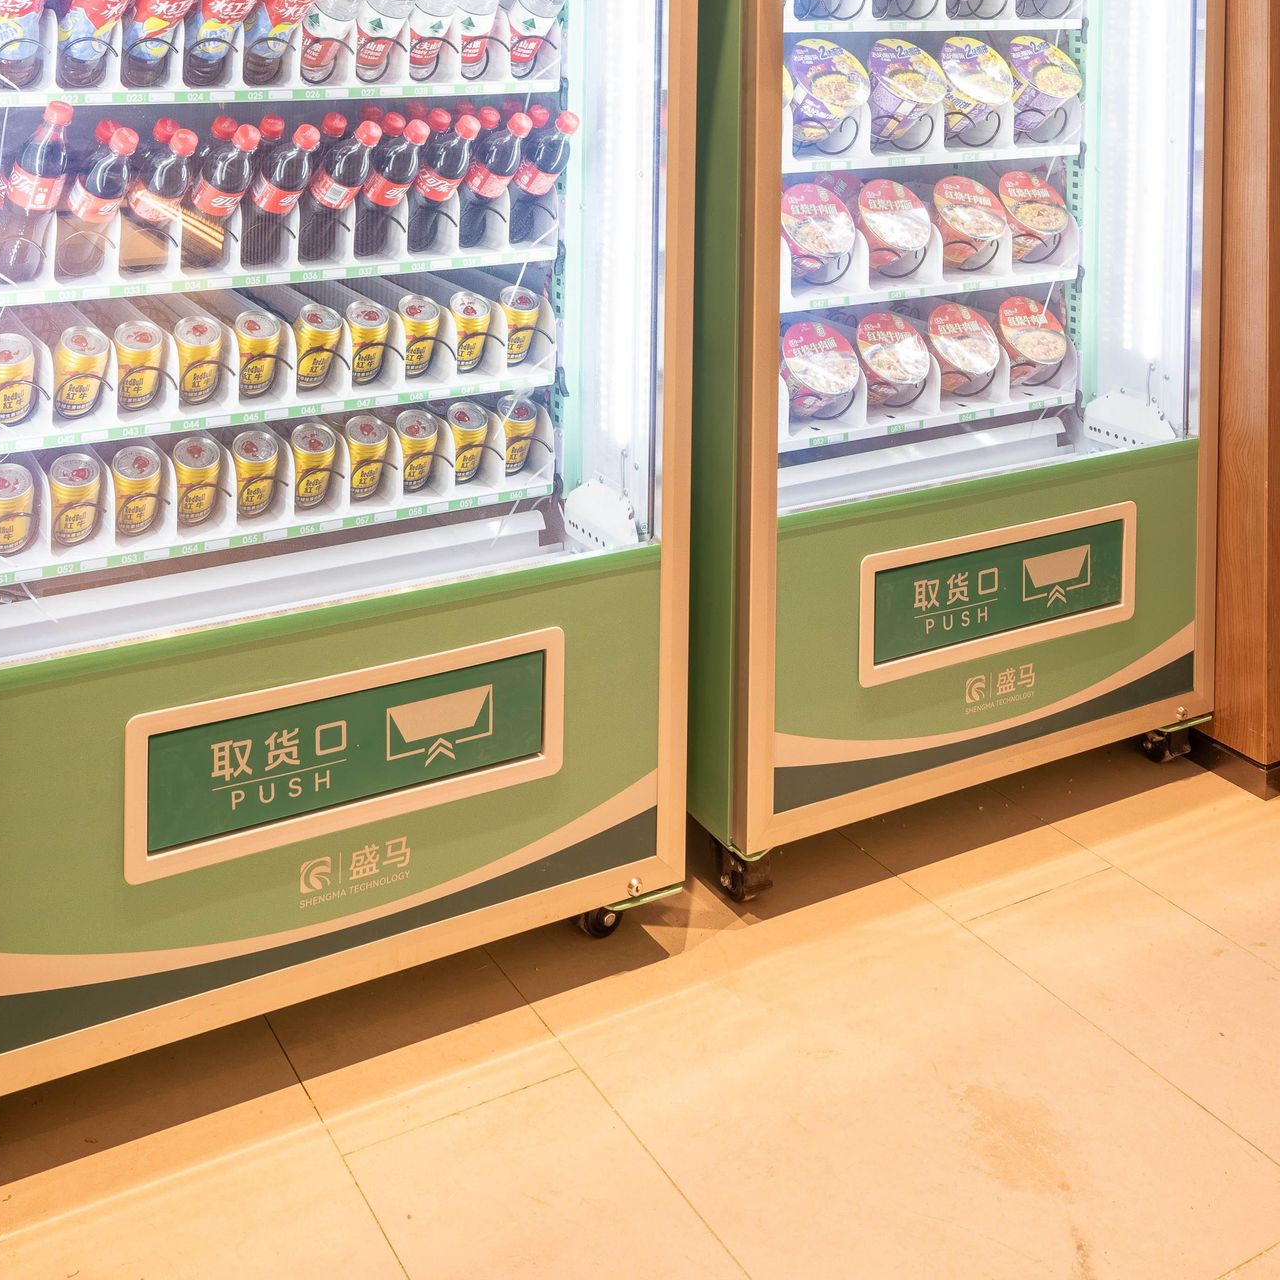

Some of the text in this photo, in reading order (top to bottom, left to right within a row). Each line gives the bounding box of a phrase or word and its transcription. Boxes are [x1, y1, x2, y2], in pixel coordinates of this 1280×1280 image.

[248, 91, 263, 100] 025
[305, 90, 320, 98] 026
[361, 88, 376, 97] 027
[126, 94, 143, 103] 023
[187, 93, 203, 102] 024
[246, 275, 261, 285] 035
[302, 271, 318, 280] 036
[356, 399, 371, 408] 047
[301, 406, 317, 415] 046
[243, 413, 259, 422] 045
[183, 420, 200, 429] 044
[122, 427, 139, 436] 043
[510, 489, 523, 498] 060
[460, 499, 473, 508] 059
[408, 507, 422, 516] 058
[355, 516, 370, 525] 057
[299, 525, 315, 534] 056
[242, 535, 258, 544] 055
[182, 544, 198, 554] 054
[121, 554, 138, 564] 053
[57, 564, 74, 574] 052
[914, 567, 999, 611] 取货口
[925, 607, 988, 634] PUSH
[996, 663, 1036, 695] 盛马
[211, 720, 347, 781] 取货口
[231, 770, 331, 810] PUSH
[349, 836, 411, 880] 盛马
[299, 870, 410, 909] SHENGMA TECHNOLOGY
